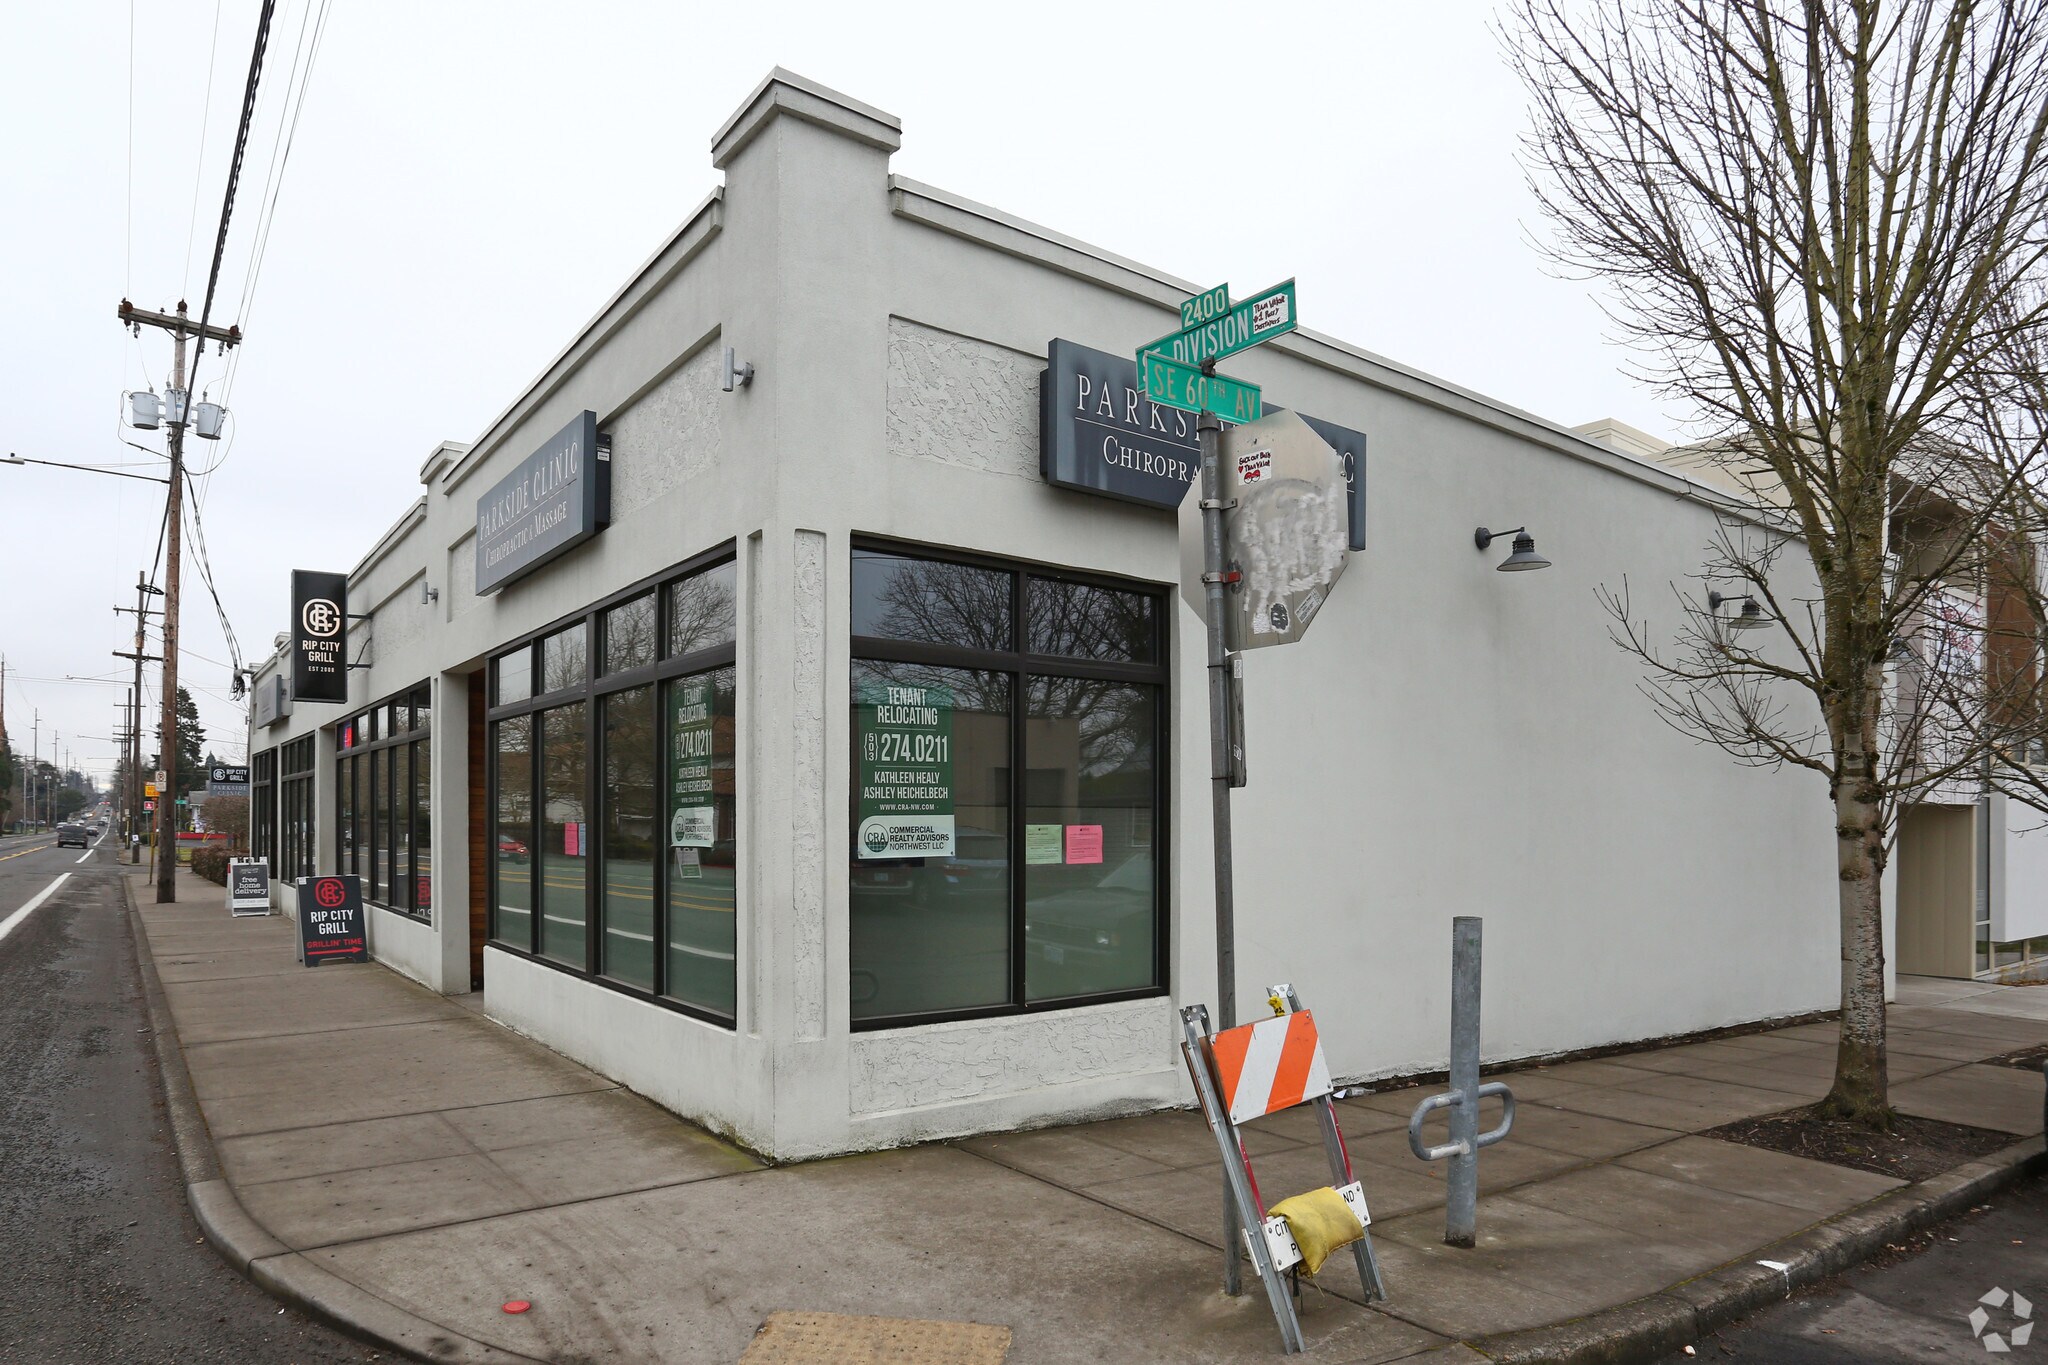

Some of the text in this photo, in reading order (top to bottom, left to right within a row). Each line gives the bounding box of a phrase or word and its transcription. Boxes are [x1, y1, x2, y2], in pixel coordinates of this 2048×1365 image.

[1184, 288, 1226, 328] 2400
[1173, 309, 1249, 363] DIVISION
[1154, 364, 1176, 400] SE
[1235, 388, 1255, 421] AV
[480, 442, 578, 541] PARKSIDE CLINIC
[303, 640, 340, 652] RIP CITY
[308, 651, 335, 663] GRILL
[684, 687, 702, 706] TENANT
[887, 687, 927, 706] TENANT
[679, 703, 707, 724] RELOCATING
[877, 705, 938, 726] RELOCATING
[681, 729, 712, 759] 274.0211
[881, 733, 948, 762] 274.0211
[874, 771, 940, 784] KATHLEEN HEALY
[864, 786, 948, 799] ASHLEY HEICHELBECH
[880, 803, 935, 811] WWW.CRA-NW.COM
[889, 826, 934, 834] COMMERCIAL
[867, 832, 886, 843] CRA
[889, 834, 949, 842] REALTY ADVISORS
[889, 842, 944, 851] NORTHWEST LLC
[310, 909, 353, 923] RIP CITY
[318, 921, 349, 935] GRILL
[343, 938, 363, 946] TIME
